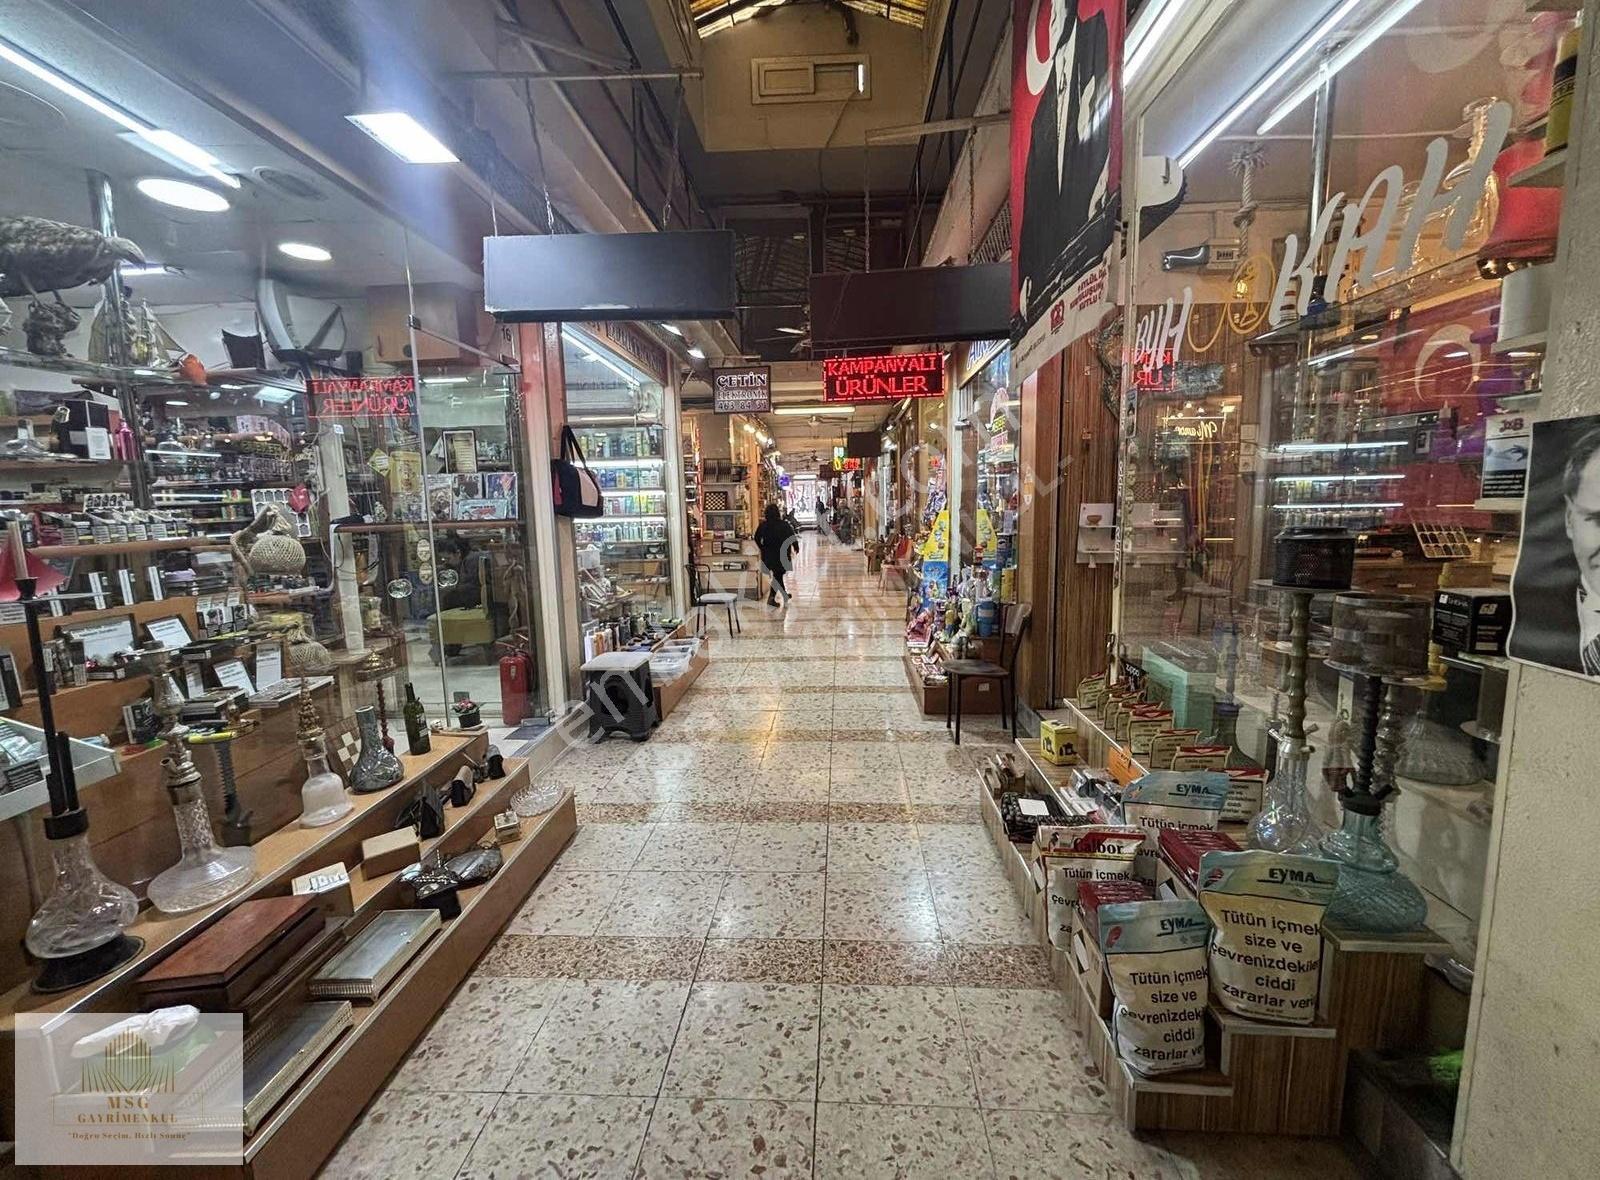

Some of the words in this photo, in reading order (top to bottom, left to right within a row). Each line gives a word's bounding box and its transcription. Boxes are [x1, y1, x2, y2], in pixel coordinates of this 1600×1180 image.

[828, 356, 937, 376] KAMPANYALI
[717, 371, 768, 391] ÇETİN
[835, 374, 928, 396] ÜRÜNLER
[719, 400, 735, 410] 463
[1175, 783, 1217, 797] EYMA
[1063, 868, 1092, 879] Tütün
[1269, 867, 1321, 884] EYMA
[1160, 917, 1199, 936] EYMA
[1221, 910, 1267, 928] Tütün
[1272, 916, 1321, 935] içmek
[1245, 933, 1277, 949] size
[1281, 940, 1302, 953] ve
[1130, 972, 1170, 986] Tütün
[1174, 966, 1209, 985] içmek
[1255, 975, 1296, 991] ciddi
[1151, 992, 1178, 1004] size
[1182, 991, 1197, 1002] ve
[1222, 982, 1286, 1007] zararlar
[1164, 1028, 1195, 1043] ciddi
[1134, 1045, 1188, 1061] zararlar
